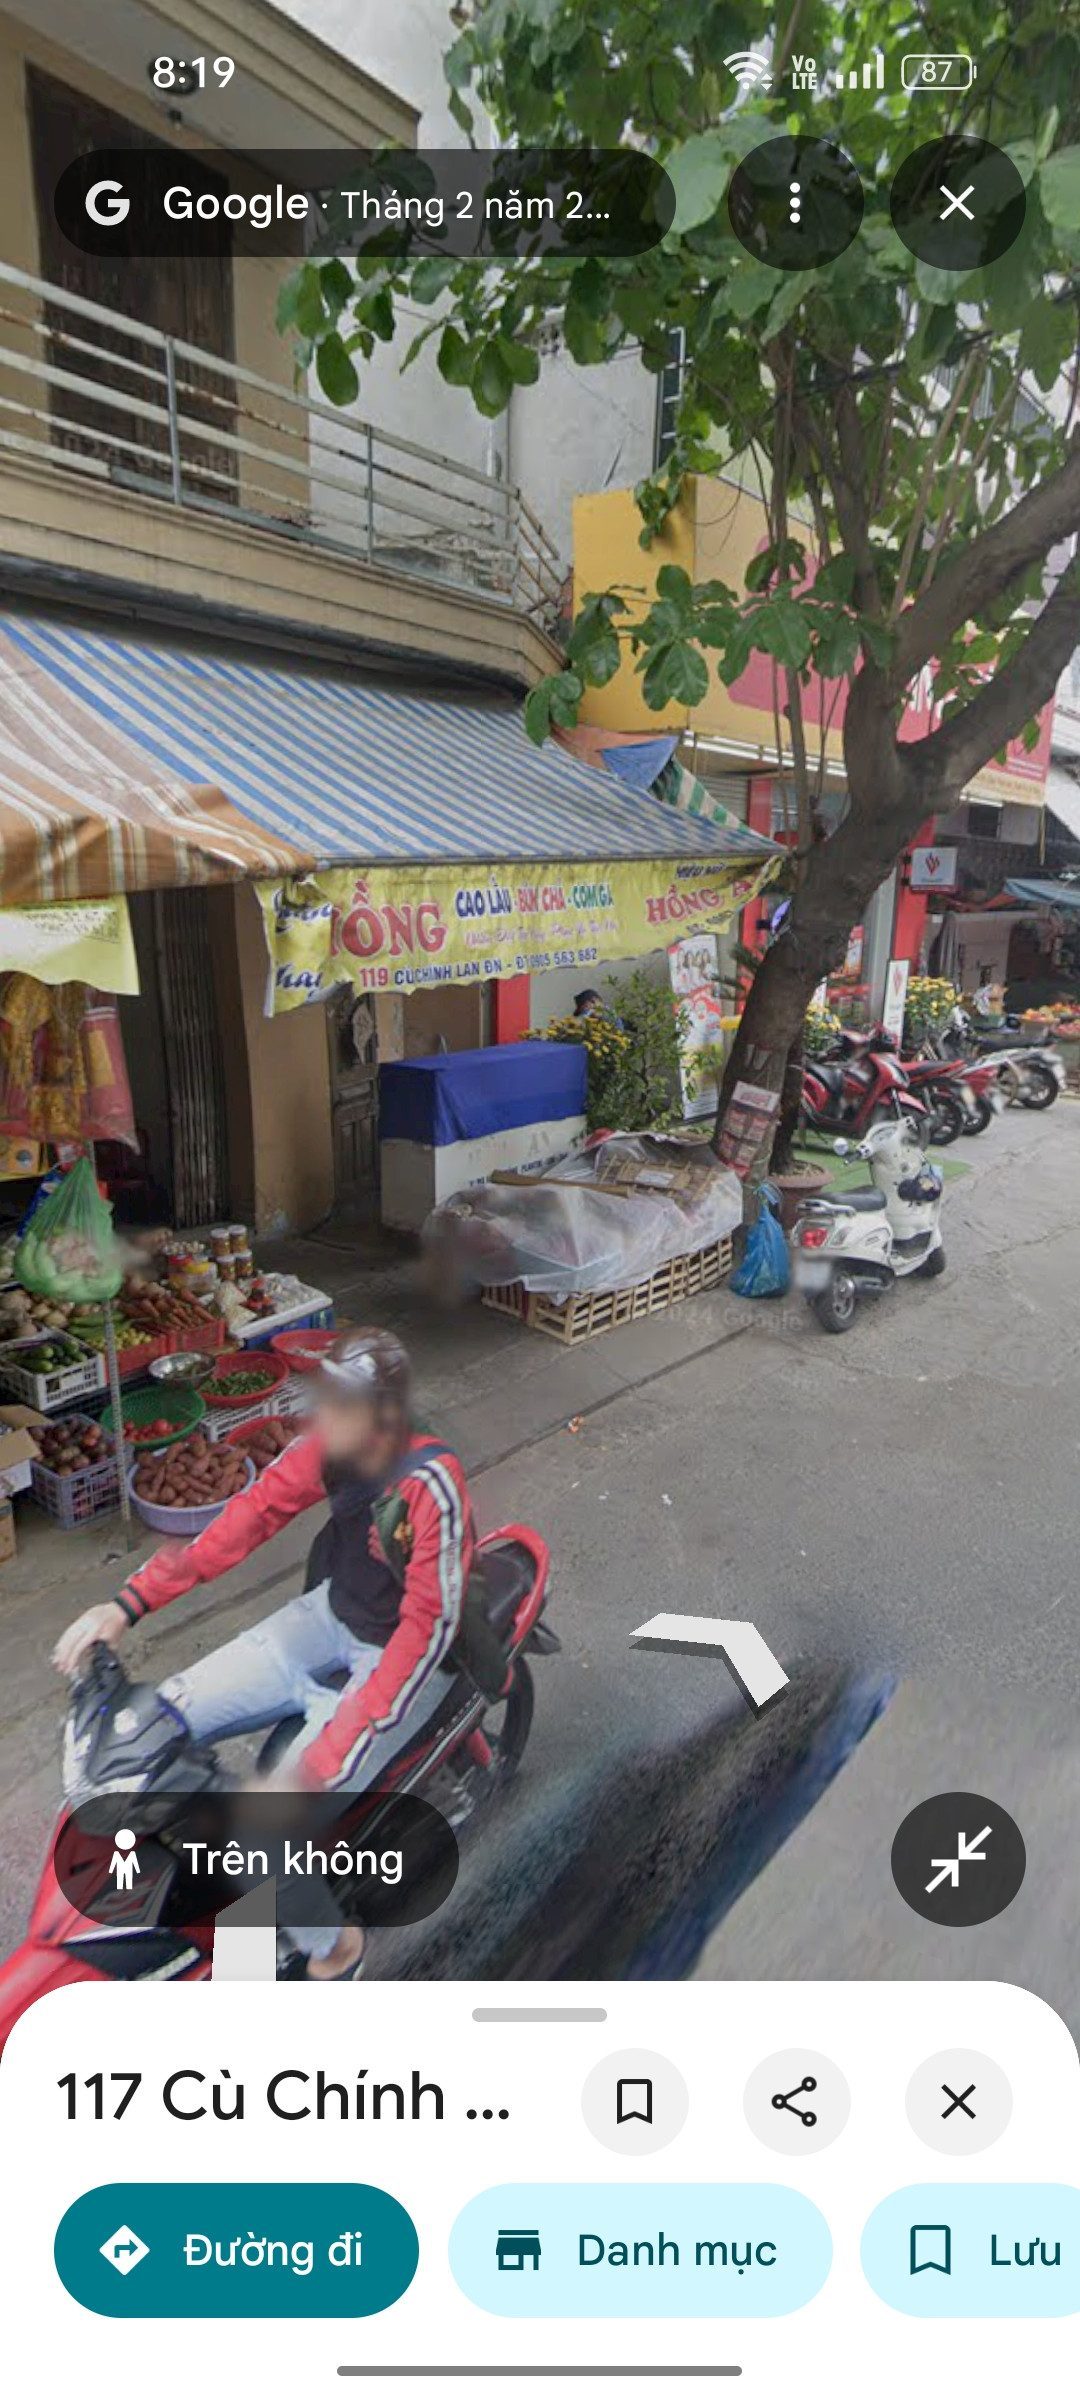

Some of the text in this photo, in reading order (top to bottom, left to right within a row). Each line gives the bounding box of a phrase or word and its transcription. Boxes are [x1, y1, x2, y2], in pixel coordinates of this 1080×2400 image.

[456, 889, 485, 917] CAO
[645, 884, 723, 922] HỒNG
[360, 967, 388, 987] 119
[456, 961, 479, 977] LAN
